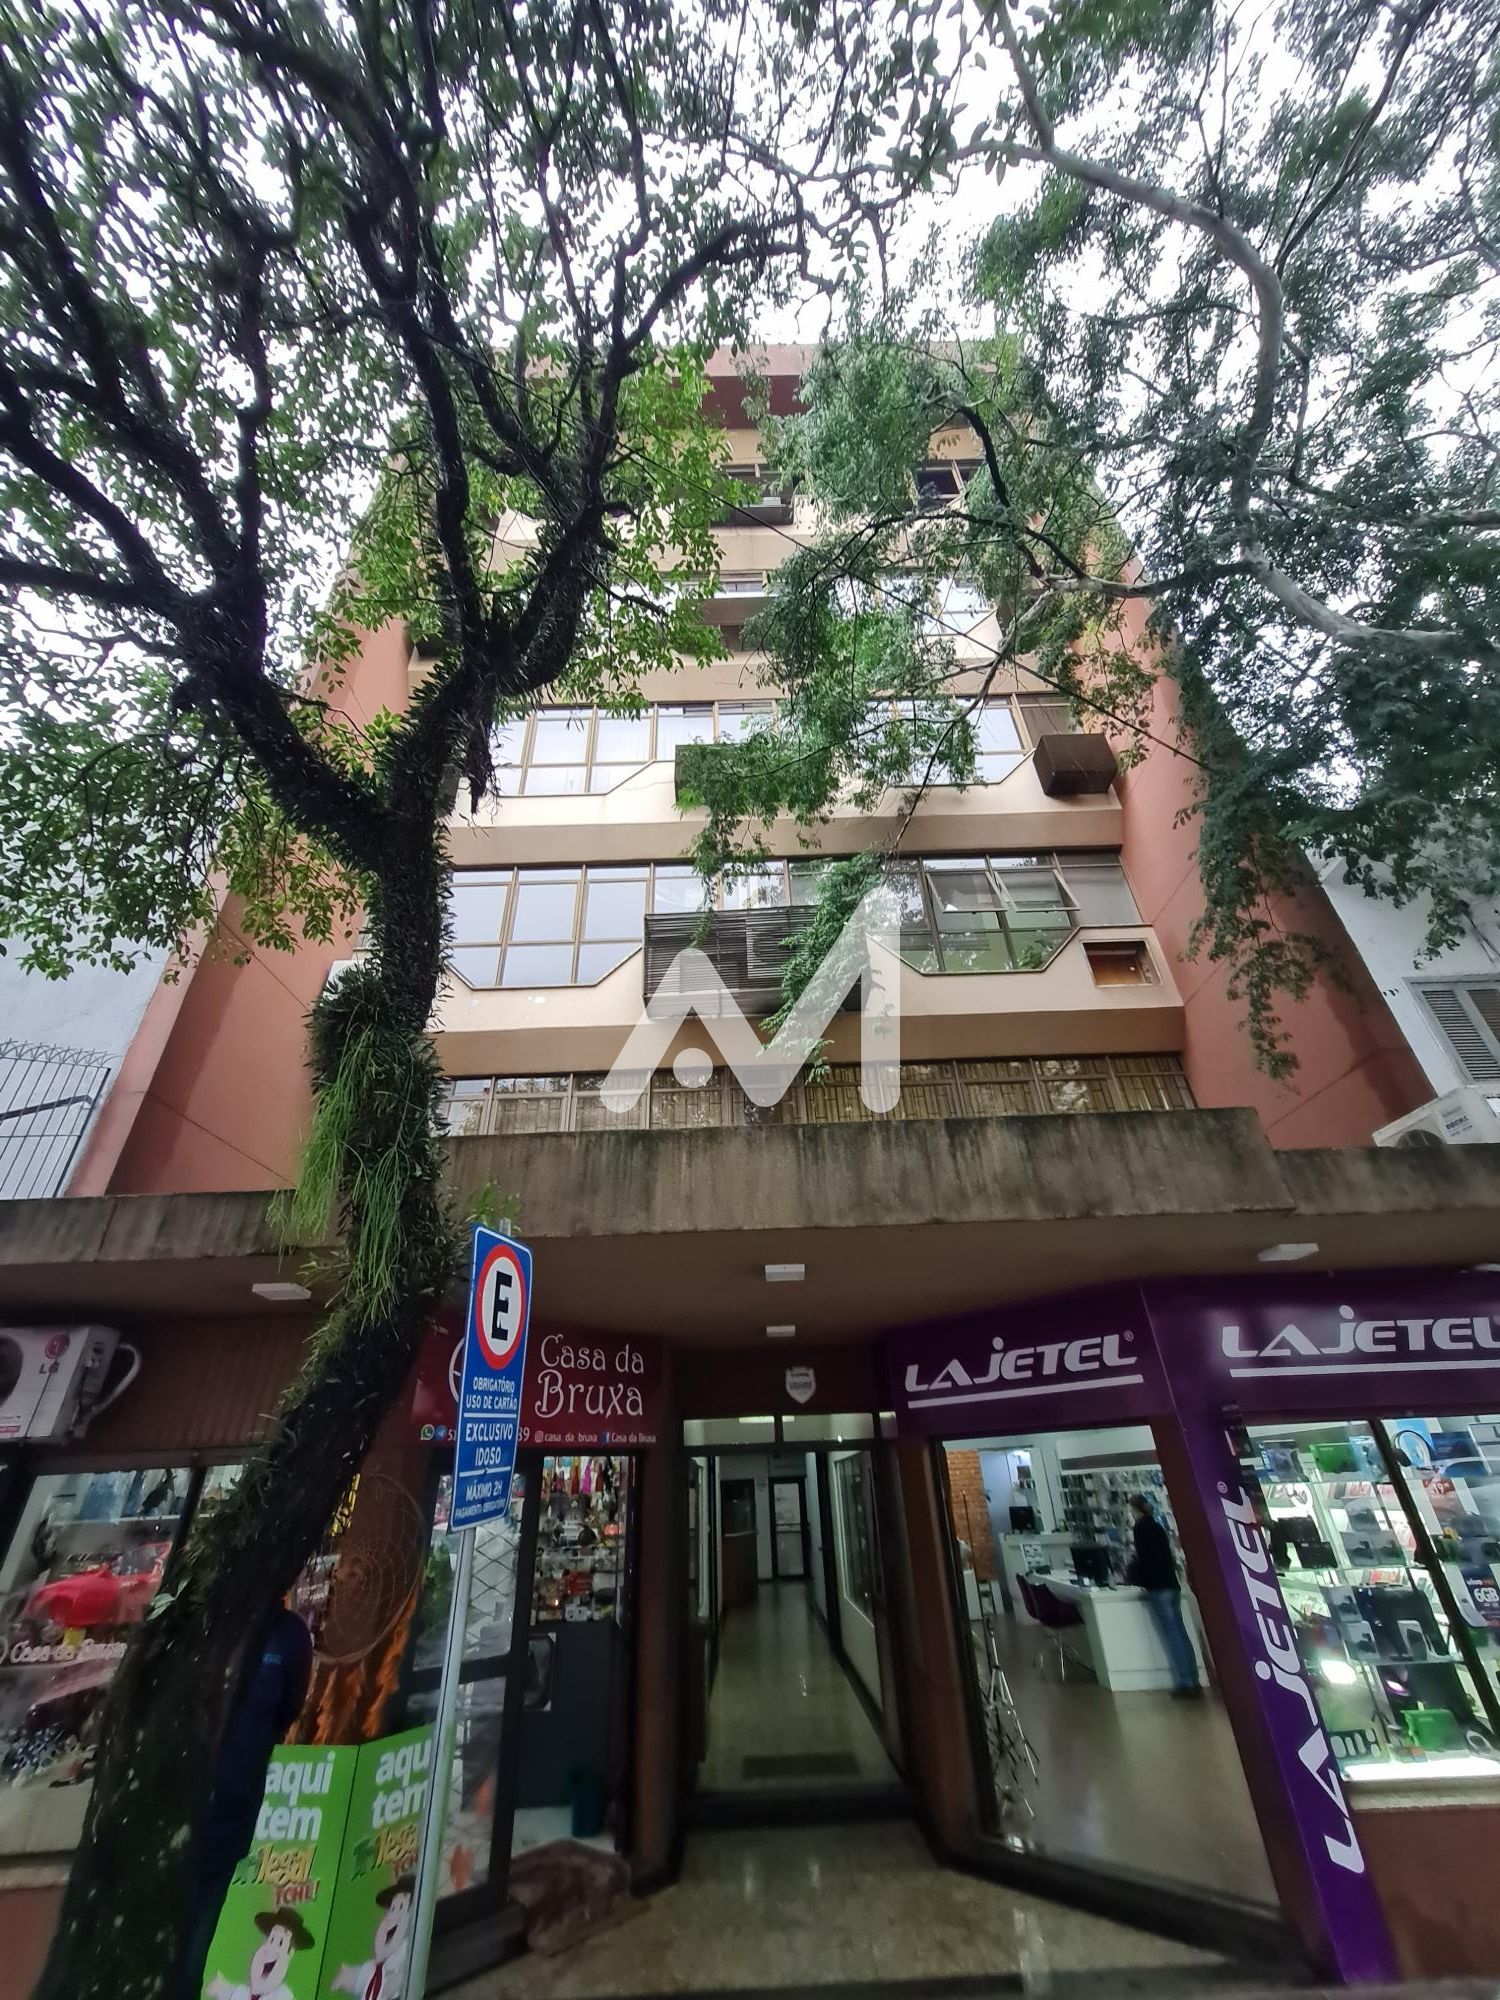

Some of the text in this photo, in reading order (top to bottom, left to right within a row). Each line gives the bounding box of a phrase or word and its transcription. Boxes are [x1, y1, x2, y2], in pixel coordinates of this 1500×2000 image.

[491, 1270, 513, 1341] E
[541, 1334, 644, 1374] Casa da
[473, 1376, 515, 1393] OBRIGATÓRIO
[535, 1369, 643, 1419] Bruxa
[466, 1394, 517, 1410] USO DE CARTÃO
[465, 1423, 513, 1441] EXCLUSIVO
[475, 1446, 501, 1466] IDOSO
[466, 1480, 492, 1501] MÁXIMO
[1473, 1587, 1500, 1603] 6GB
[265, 1751, 336, 1807] aqui
[255, 1801, 323, 1841] tem
